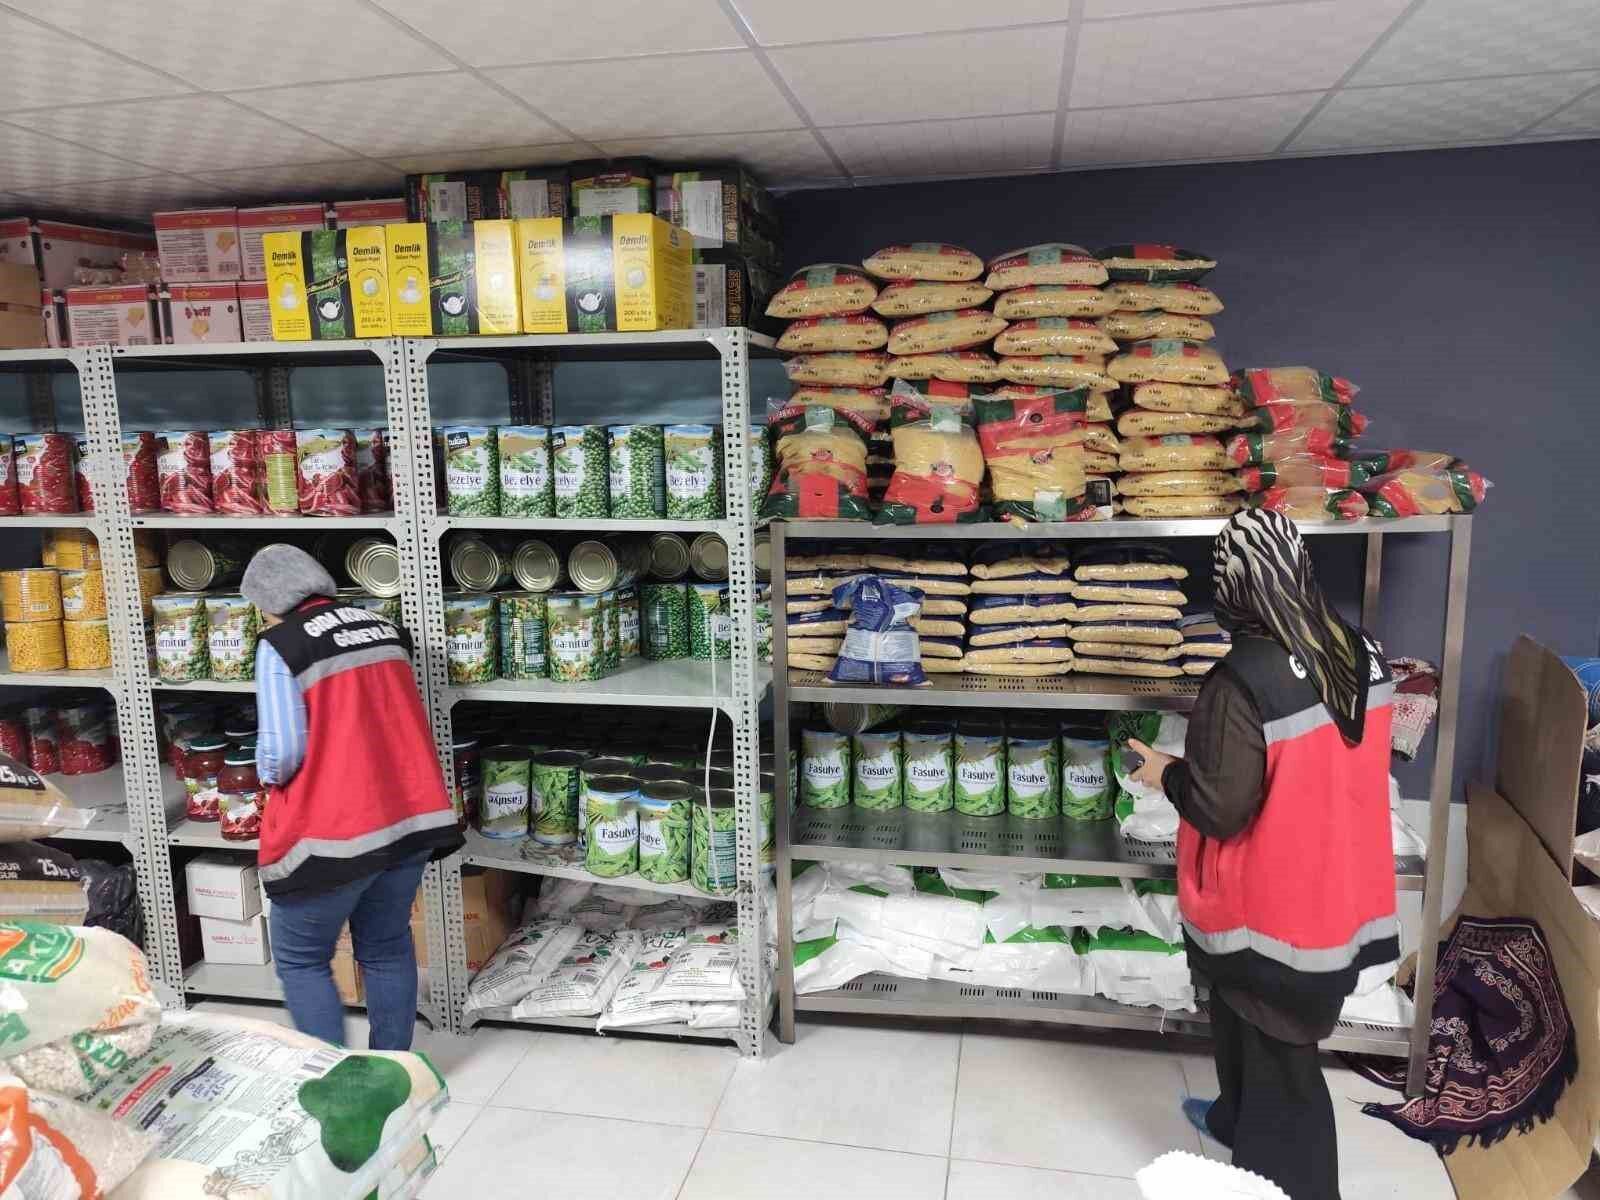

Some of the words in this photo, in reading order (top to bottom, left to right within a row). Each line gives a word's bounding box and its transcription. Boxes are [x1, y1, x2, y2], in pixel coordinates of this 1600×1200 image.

[353, 246, 381, 256] Demlik
[394, 242, 421, 253] Demlik
[271, 250, 297, 261] Demlik
[808, 762, 841, 775] Fasulye
[862, 764, 894, 777] Fasulye
[912, 765, 946, 778] Fasulye
[961, 767, 996, 781] Fasulye
[1012, 770, 1046, 783] Fasulye
[1069, 771, 1105, 785] Fasulye
[600, 826, 637, 840] Fasulye
[37, 858, 59, 877] 25
